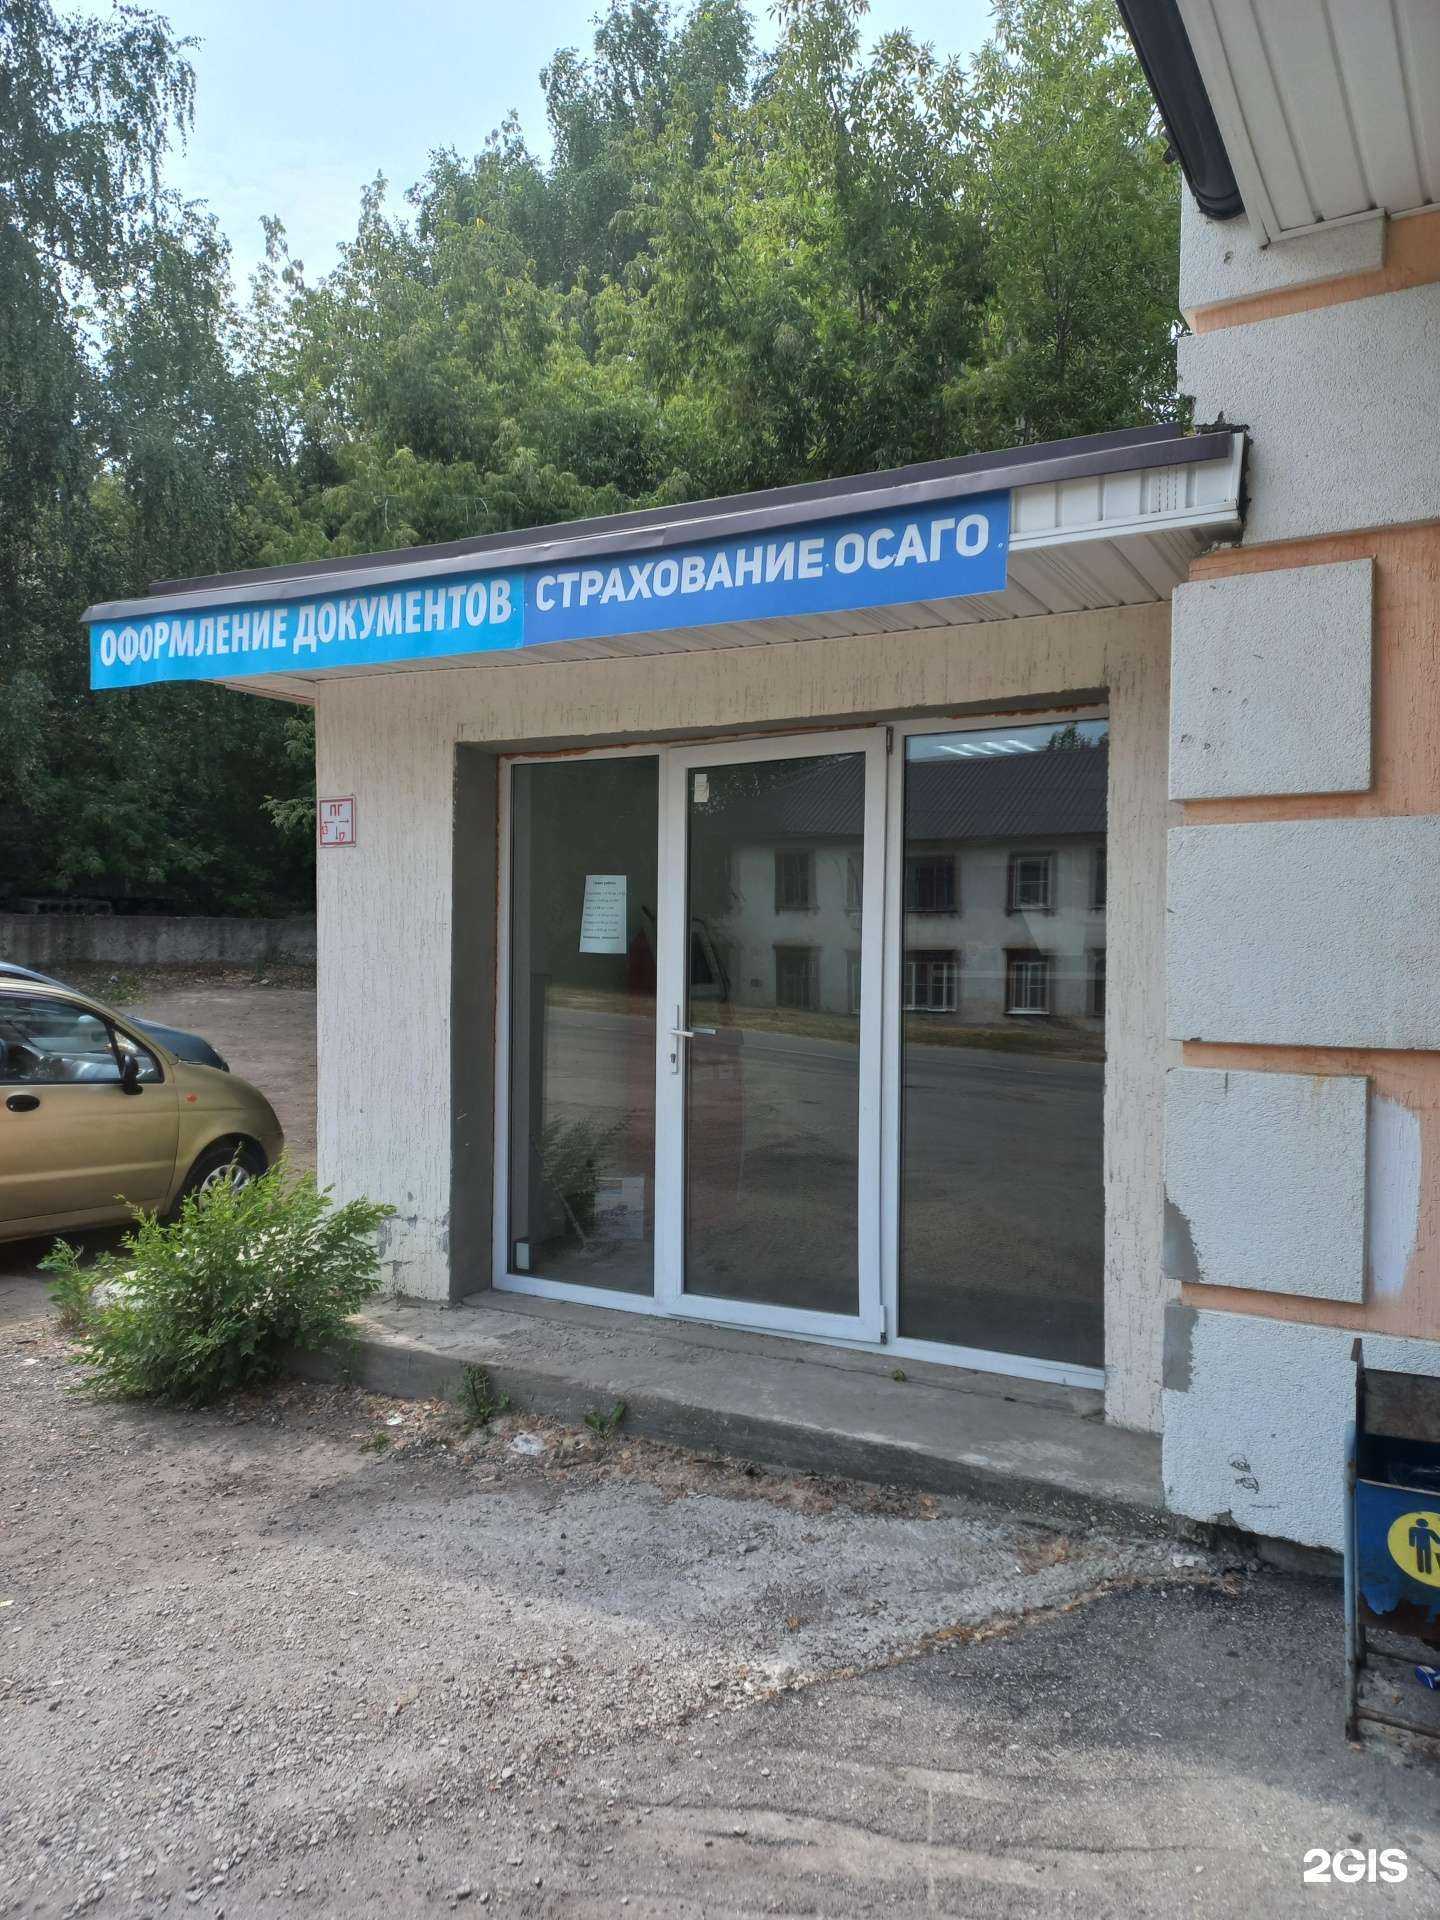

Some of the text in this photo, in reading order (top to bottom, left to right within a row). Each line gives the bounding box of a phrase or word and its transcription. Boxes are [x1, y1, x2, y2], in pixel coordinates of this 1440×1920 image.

[536, 514, 989, 612] СТРАХОВАНИЕ ОСАГО
[100, 580, 512, 667] ОФОРМЛЕНИЕ ДОКУМЕНТОВ
